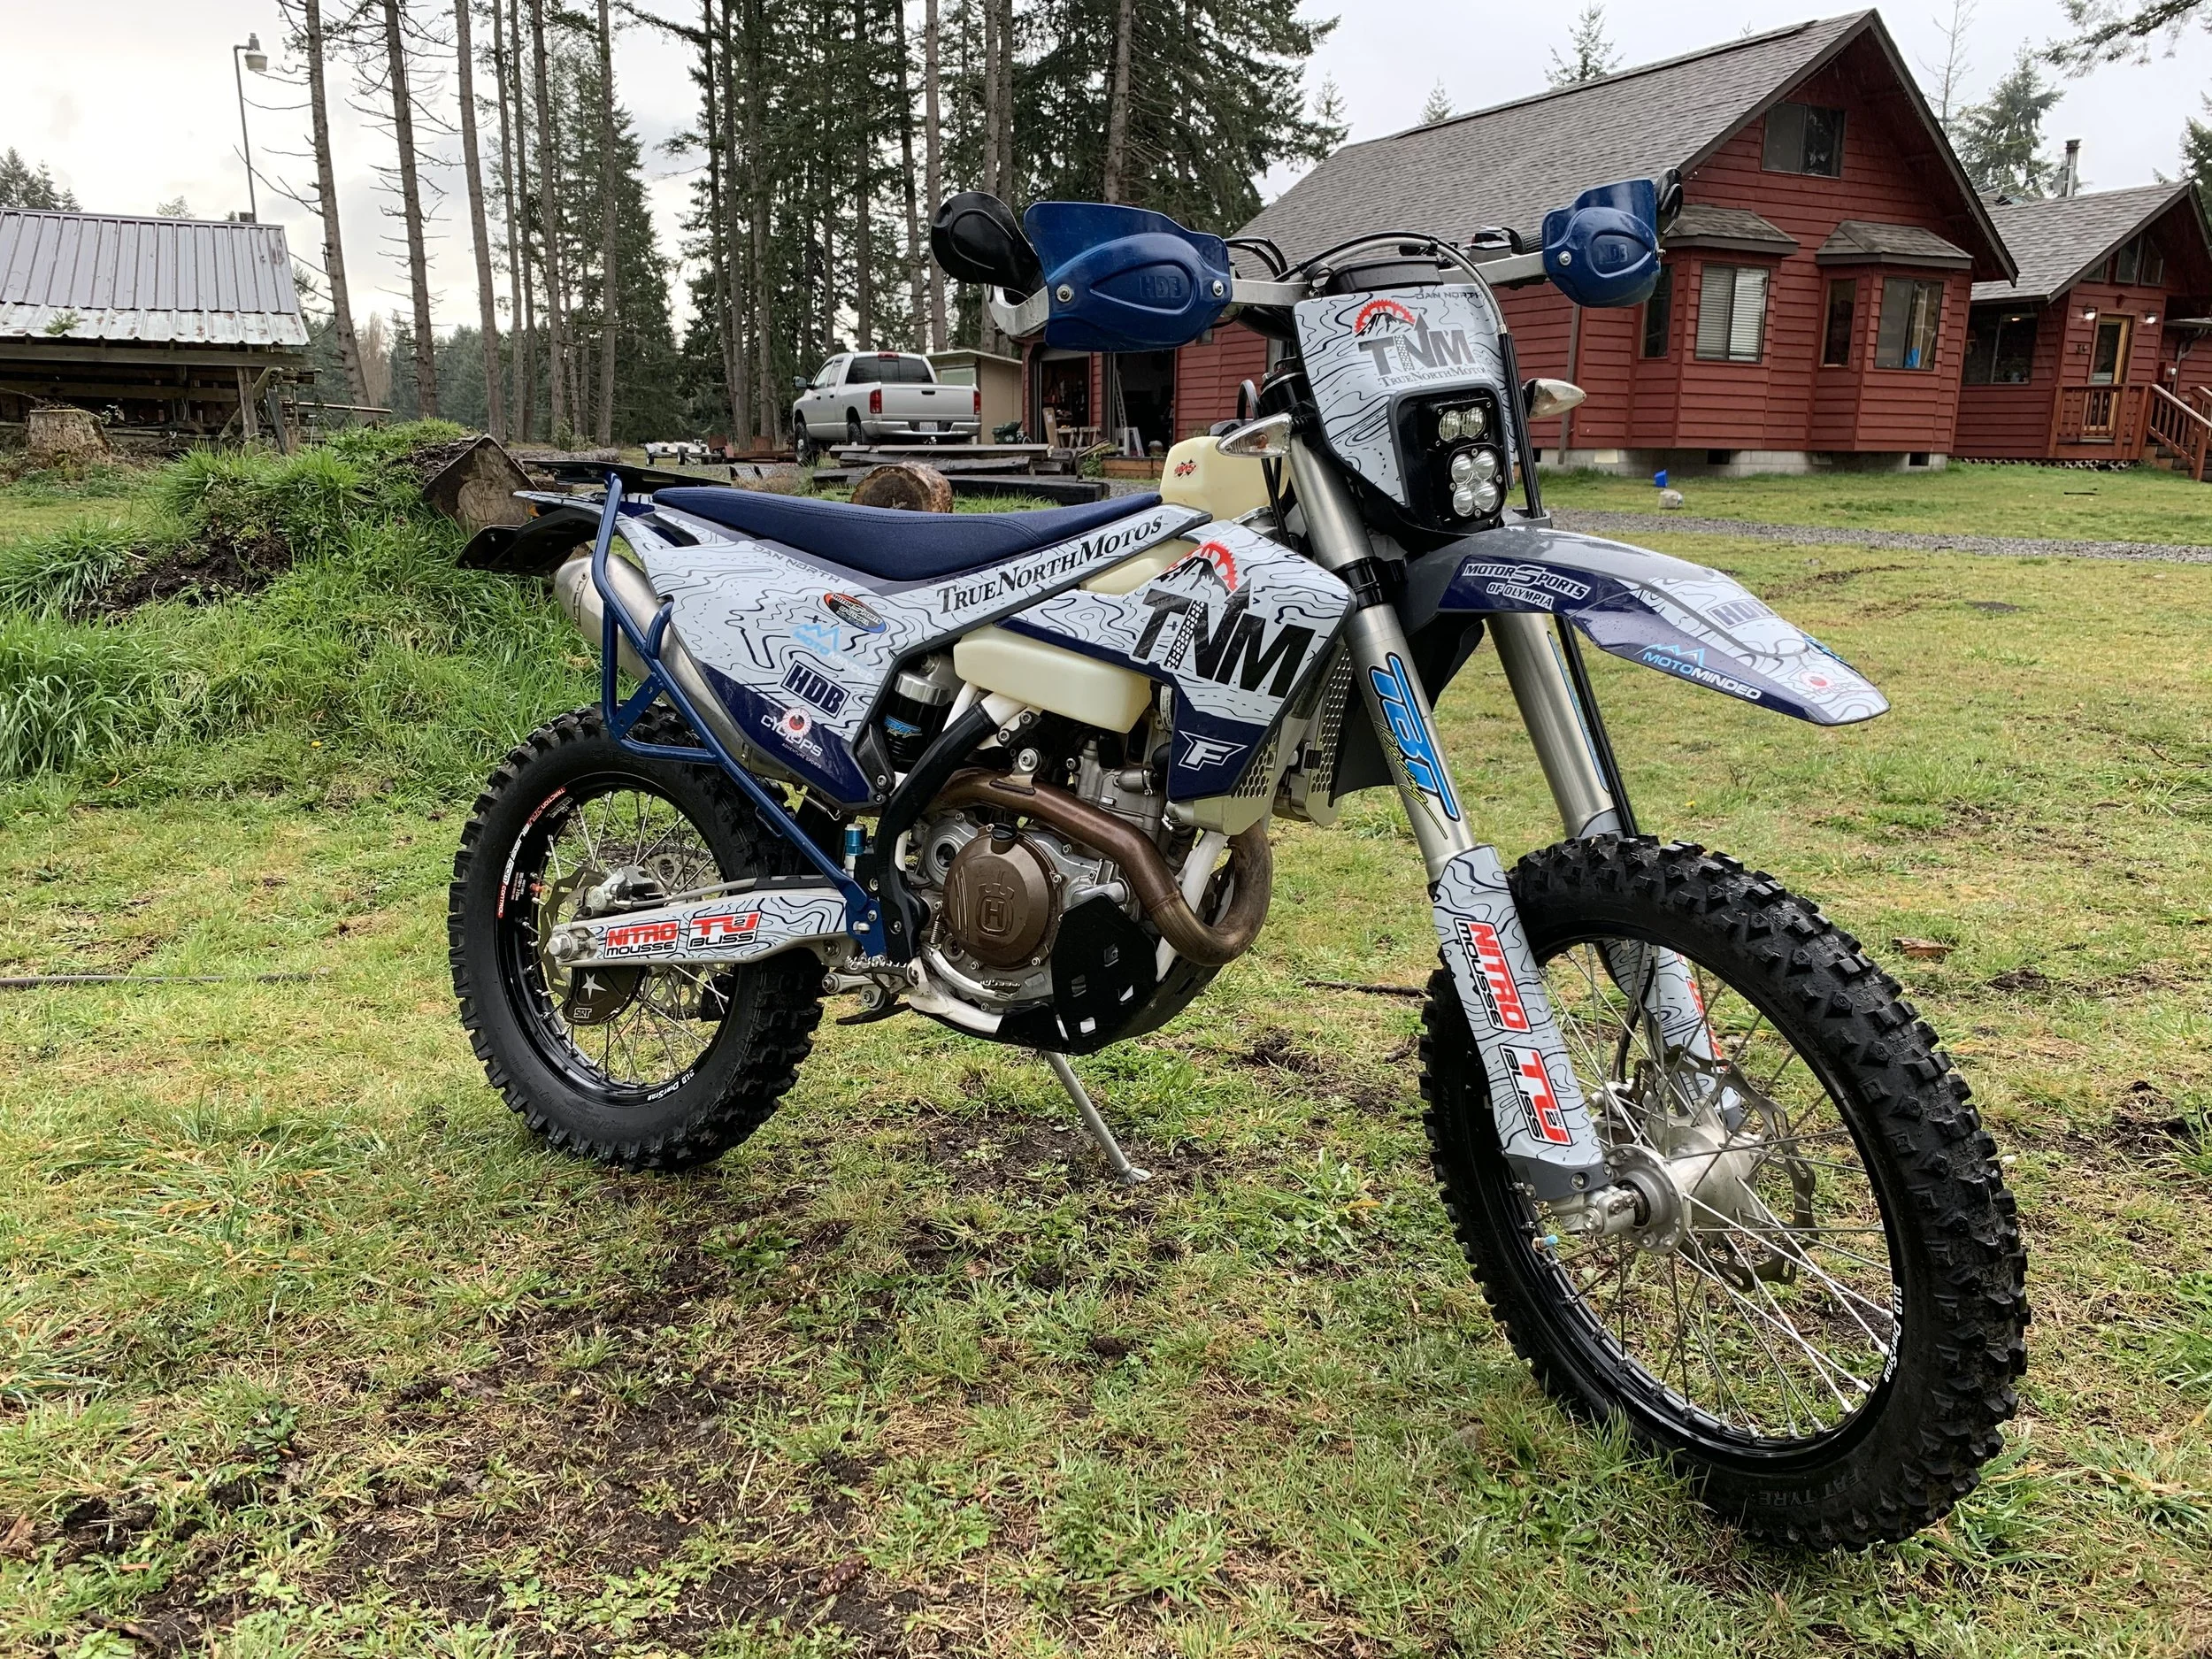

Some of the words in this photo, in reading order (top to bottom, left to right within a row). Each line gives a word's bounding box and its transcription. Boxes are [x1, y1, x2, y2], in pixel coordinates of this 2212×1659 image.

[1358, 312, 1476, 376] TNM
[752, 545, 784, 561] DAN
[786, 558, 841, 584] NORTH
[1486, 582, 1504, 595] OF
[1502, 585, 1554, 611] OLYMPIA
[1132, 577, 1317, 699] TNM
[785, 661, 846, 715] HDB
[760, 714, 824, 758] CYCLOPS
[781, 743, 805, 759] ADVENTURE
[804, 757, 822, 770] SPORTS
[606, 941, 675, 956] MOUSSE
[608, 923, 677, 947] NITRO
[690, 932, 755, 948] BLISS
[1458, 922, 1504, 1027] MOUSSE
[1469, 923, 1528, 1030] NITRO
[574, 1008, 592, 1018] SRT
[1503, 1048, 1545, 1139] BLISS
[1545, 1110, 1557, 1126] 2
